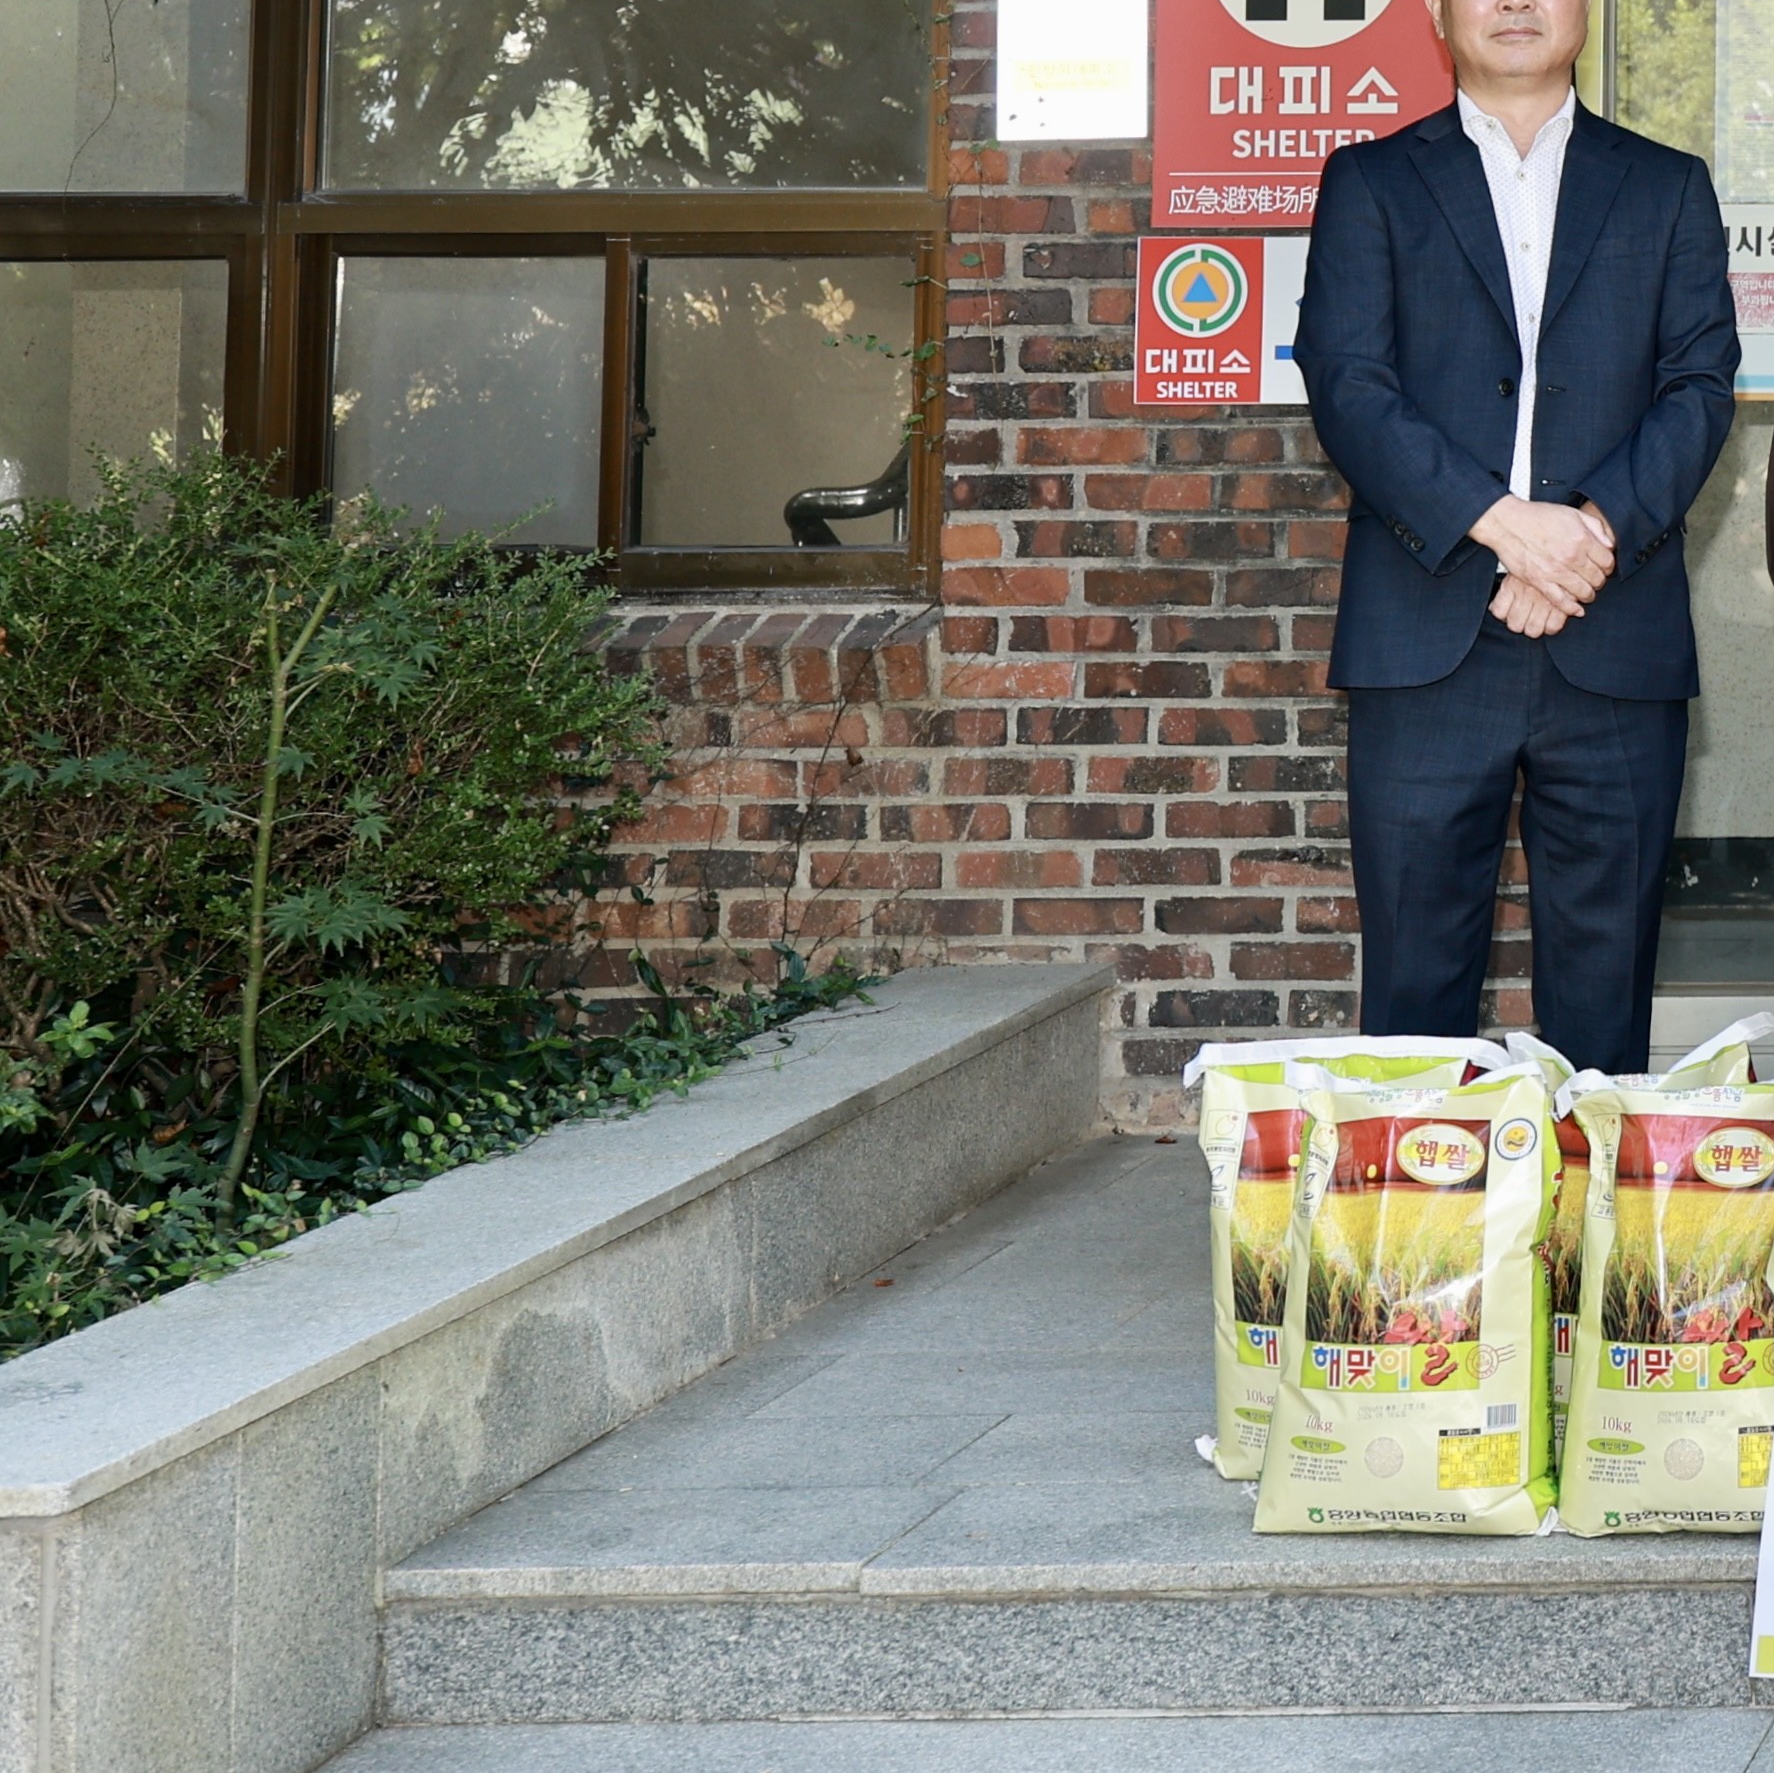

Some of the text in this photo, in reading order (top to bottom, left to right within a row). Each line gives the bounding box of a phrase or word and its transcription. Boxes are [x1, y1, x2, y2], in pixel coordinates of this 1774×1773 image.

[1210, 65, 1399, 115] 대피소
[1145, 348, 1251, 374] 대피소
[1156, 381, 1238, 399] SHELTER
[1416, 1140, 1470, 1170] 햅쌀
[1711, 1145, 1763, 1172] 햅쌀
[1312, 1345, 1412, 1390] 해맞이
[1610, 1344, 1709, 1389] 해맞이
[1305, 1414, 1334, 1434] 10kg
[1600, 1415, 1632, 1434] 10kg
